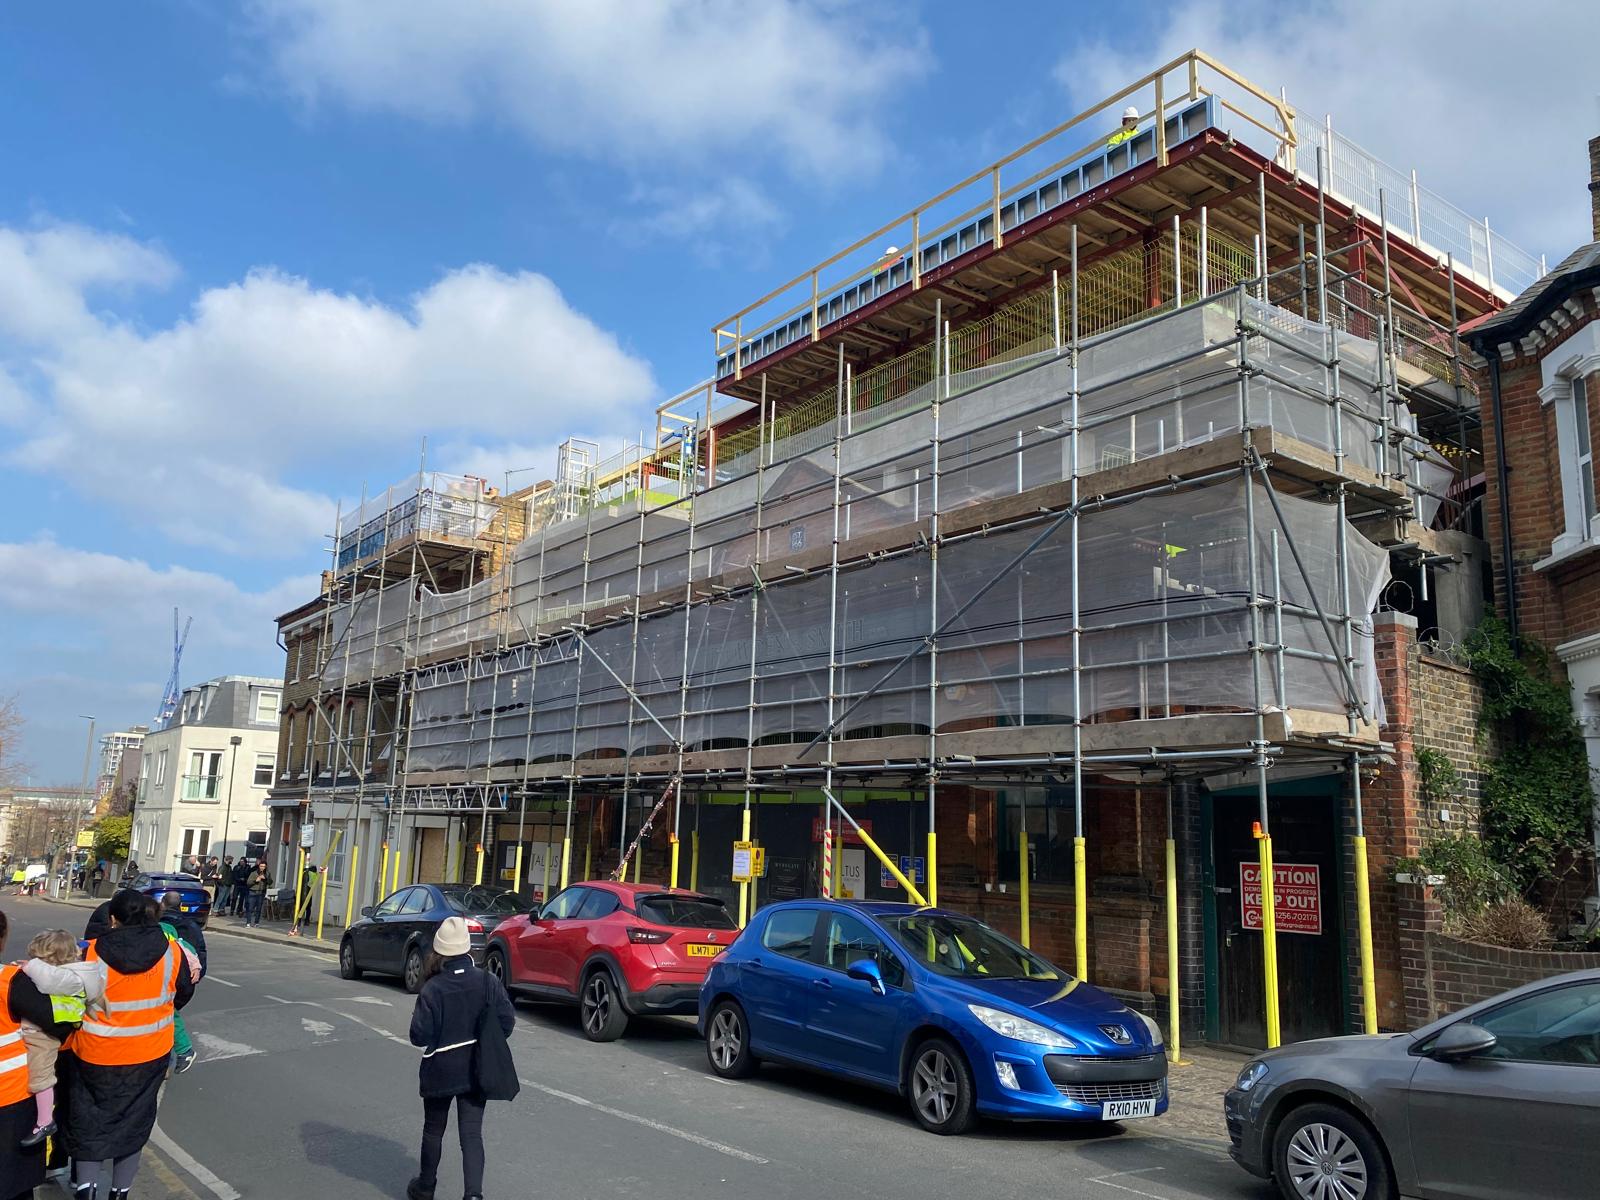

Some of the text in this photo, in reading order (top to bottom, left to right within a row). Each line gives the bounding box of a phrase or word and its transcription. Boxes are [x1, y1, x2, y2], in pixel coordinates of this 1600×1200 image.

[530, 854, 559, 871] TALUS
[1245, 893, 1317, 909] KEP OUT
[692, 945, 710, 955] LM71
[1109, 1101, 1151, 1117] RX10 HYN
